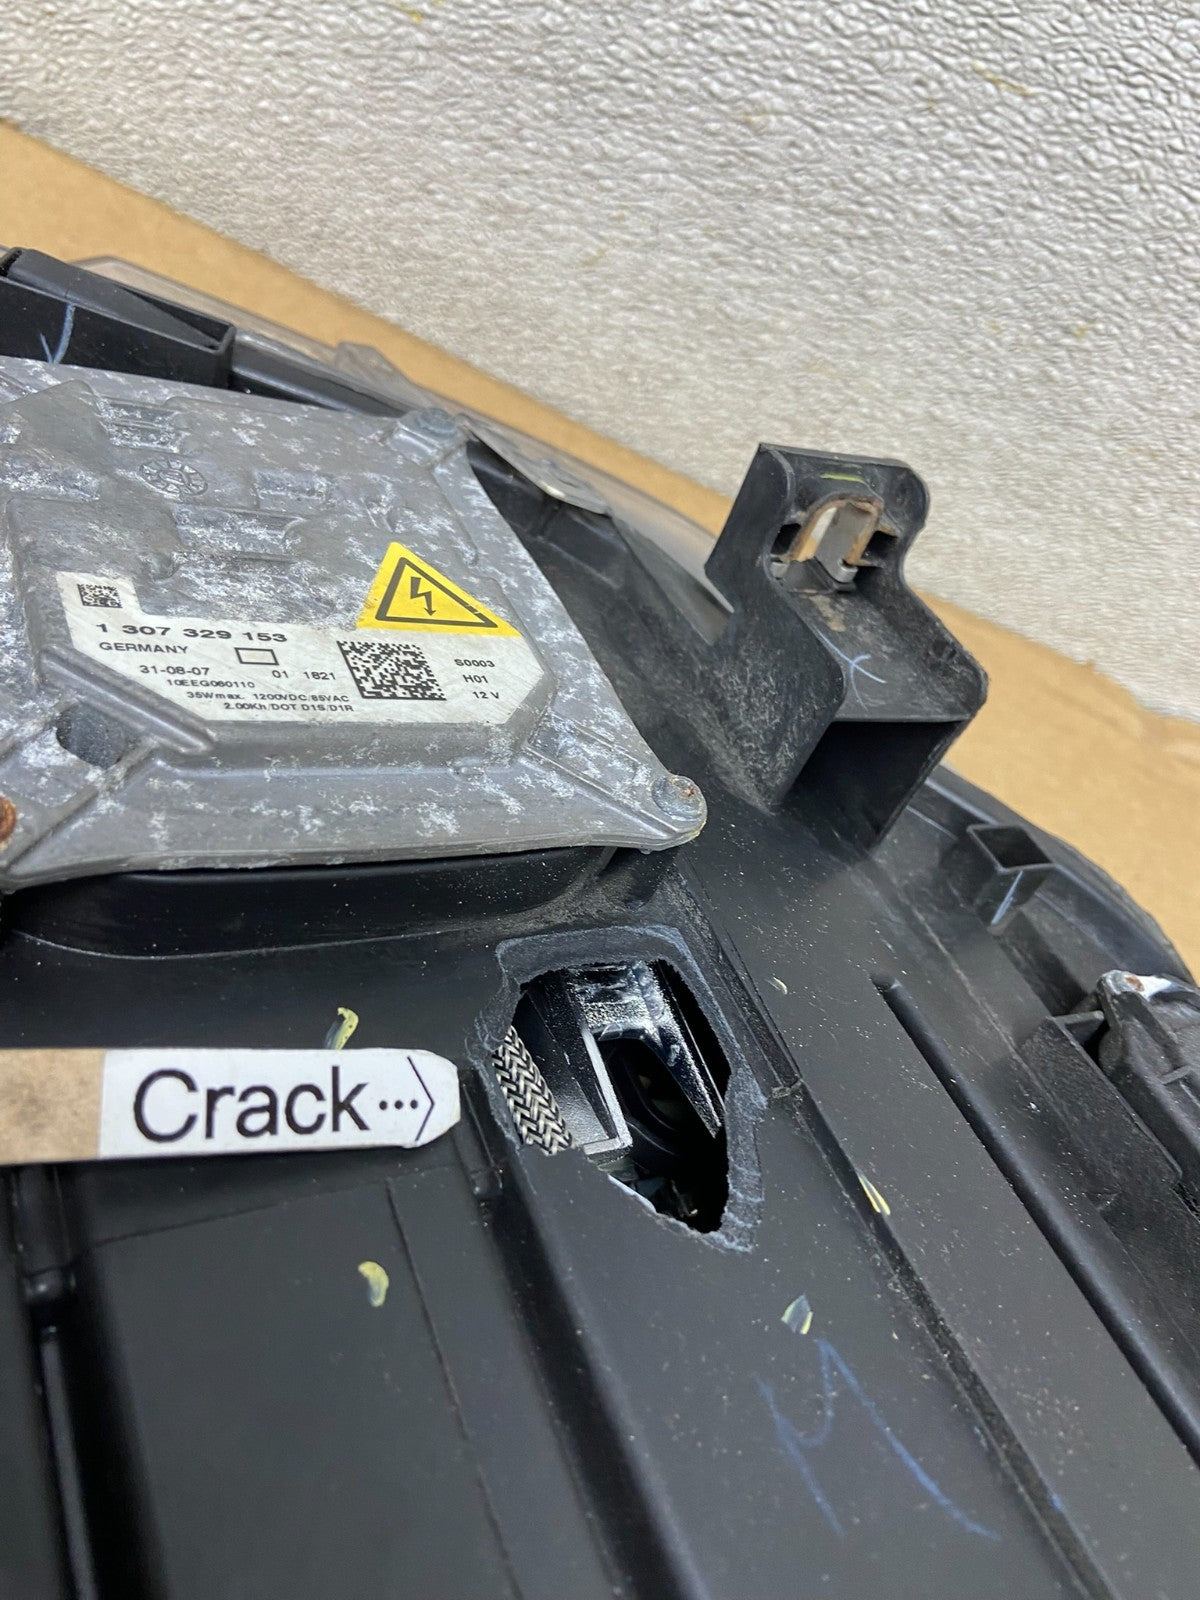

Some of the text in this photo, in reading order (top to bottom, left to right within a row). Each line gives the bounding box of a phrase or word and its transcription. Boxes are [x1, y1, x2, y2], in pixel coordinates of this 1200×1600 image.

[96, 623, 288, 643] 1 307 329 153
[99, 641, 189, 655] GERMANY
[454, 658, 496, 668] S0003
[139, 665, 337, 681] 31-08-07 01 1821
[463, 674, 489, 684] H01
[472, 691, 501, 701] 12 V
